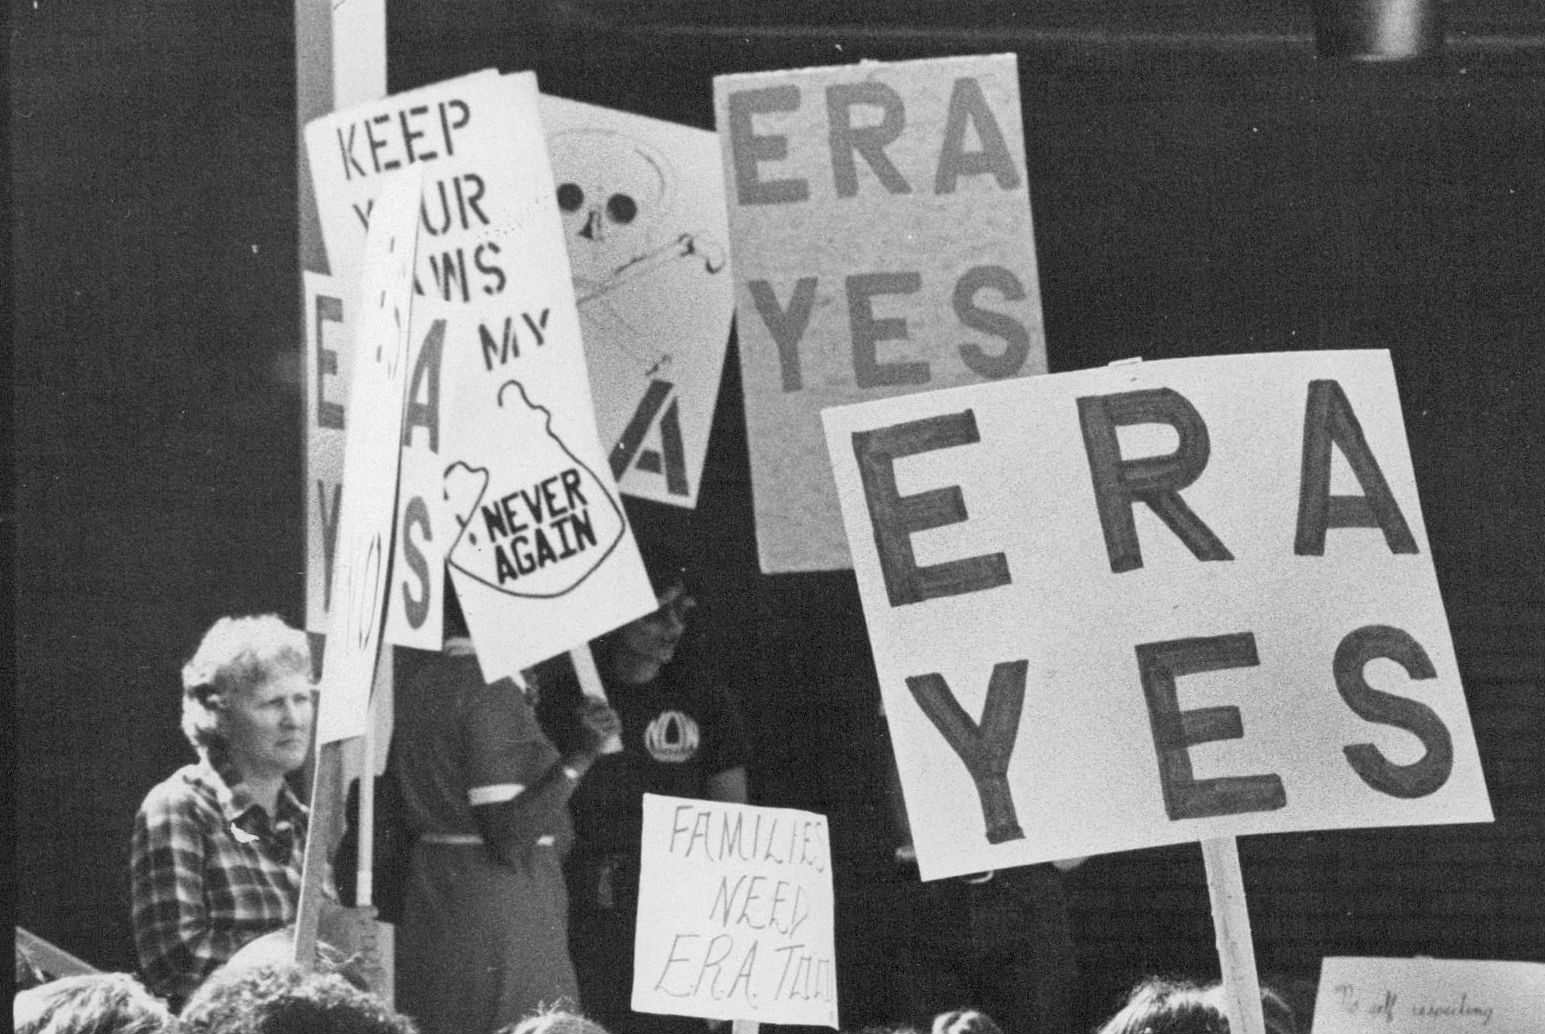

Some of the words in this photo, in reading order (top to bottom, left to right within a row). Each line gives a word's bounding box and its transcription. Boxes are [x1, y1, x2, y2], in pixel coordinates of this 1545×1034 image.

[337, 99, 471, 181] KEEP
[728, 76, 1021, 206] ERA
[352, 173, 491, 237] YUR
[478, 307, 551, 371] MY
[749, 265, 1030, 392] YES
[314, 293, 448, 455] EA
[481, 468, 589, 544] NEVER
[851, 378, 1421, 608] ERA
[494, 508, 598, 586] AGAIN
[904, 624, 1455, 845] YES
[669, 803, 828, 874] FAMILIES
[709, 874, 809, 937] NEED
